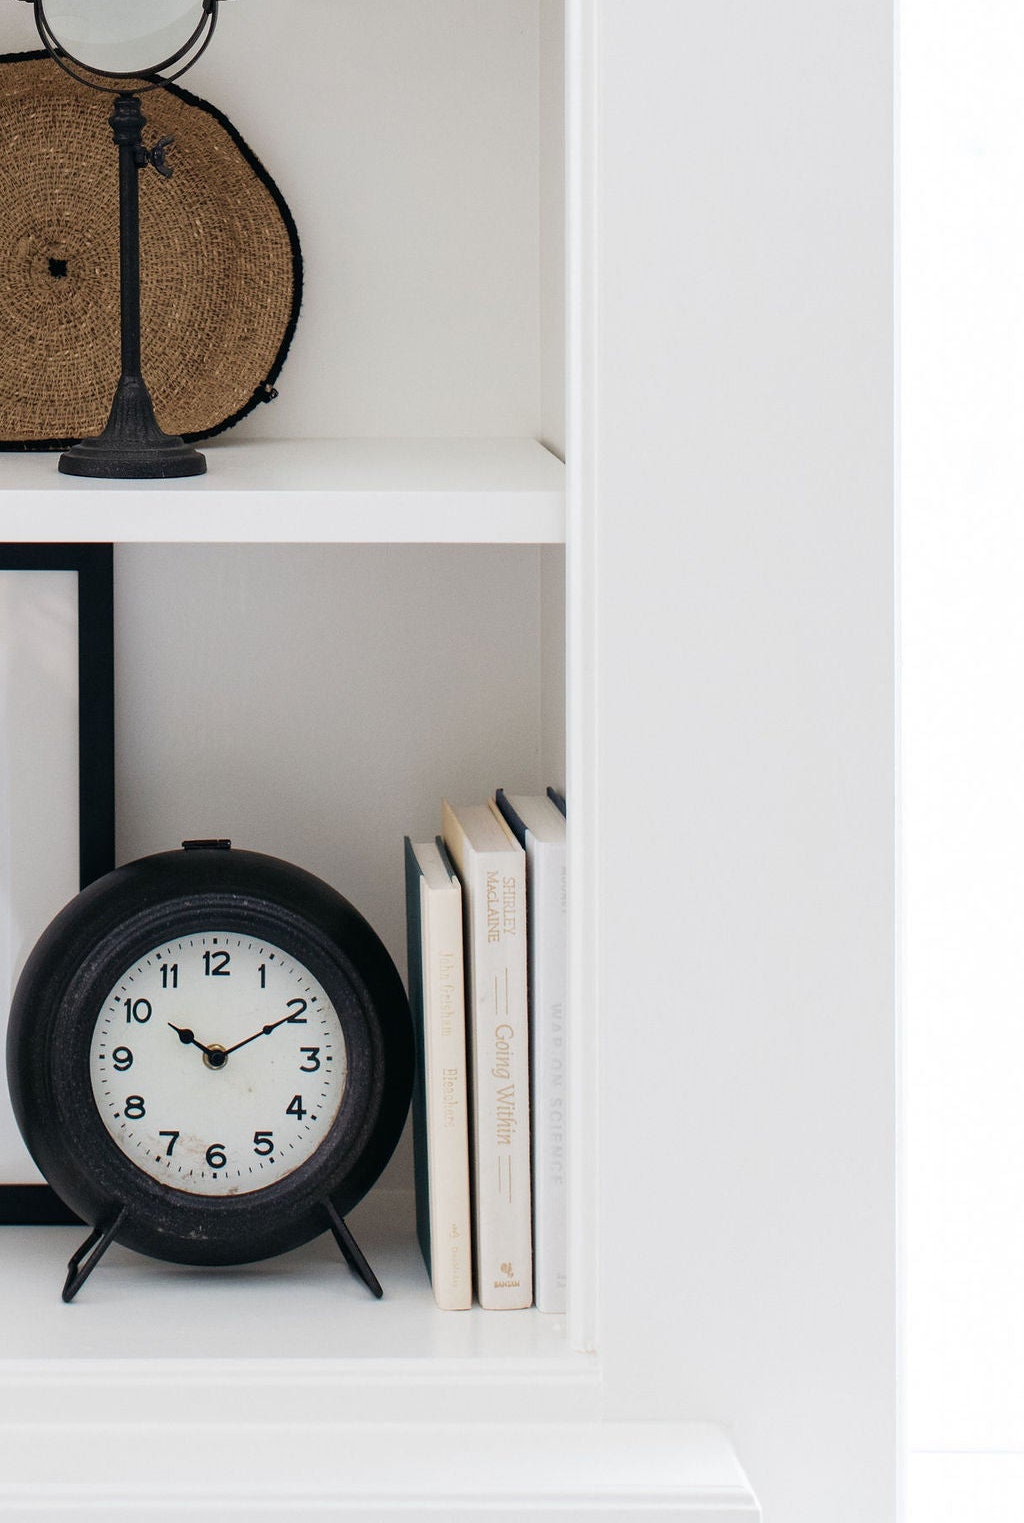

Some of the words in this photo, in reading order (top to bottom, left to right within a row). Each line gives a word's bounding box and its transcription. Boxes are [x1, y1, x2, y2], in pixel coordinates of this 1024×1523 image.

[503, 876, 516, 936] SHIRLEY
[160, 964, 178, 988] 11
[202, 951, 231, 976] 12
[257, 964, 266, 988] 1
[438, 950, 454, 980] John
[124, 998, 152, 1024] 10
[286, 998, 308, 1024] 2
[440, 984, 455, 1037] Grisham
[112, 1046, 134, 1071] 9
[299, 1047, 321, 1073] 3
[491, 1023, 515, 1079] Going
[124, 1095, 146, 1119] 8
[285, 1094, 308, 1121] 4
[496, 1083, 517, 1146] Within
[159, 1131, 180, 1156] 7
[253, 1131, 274, 1156] 5
[550, 1098, 563, 1185] SCIENCE
[205, 1143, 227, 1169] 6
